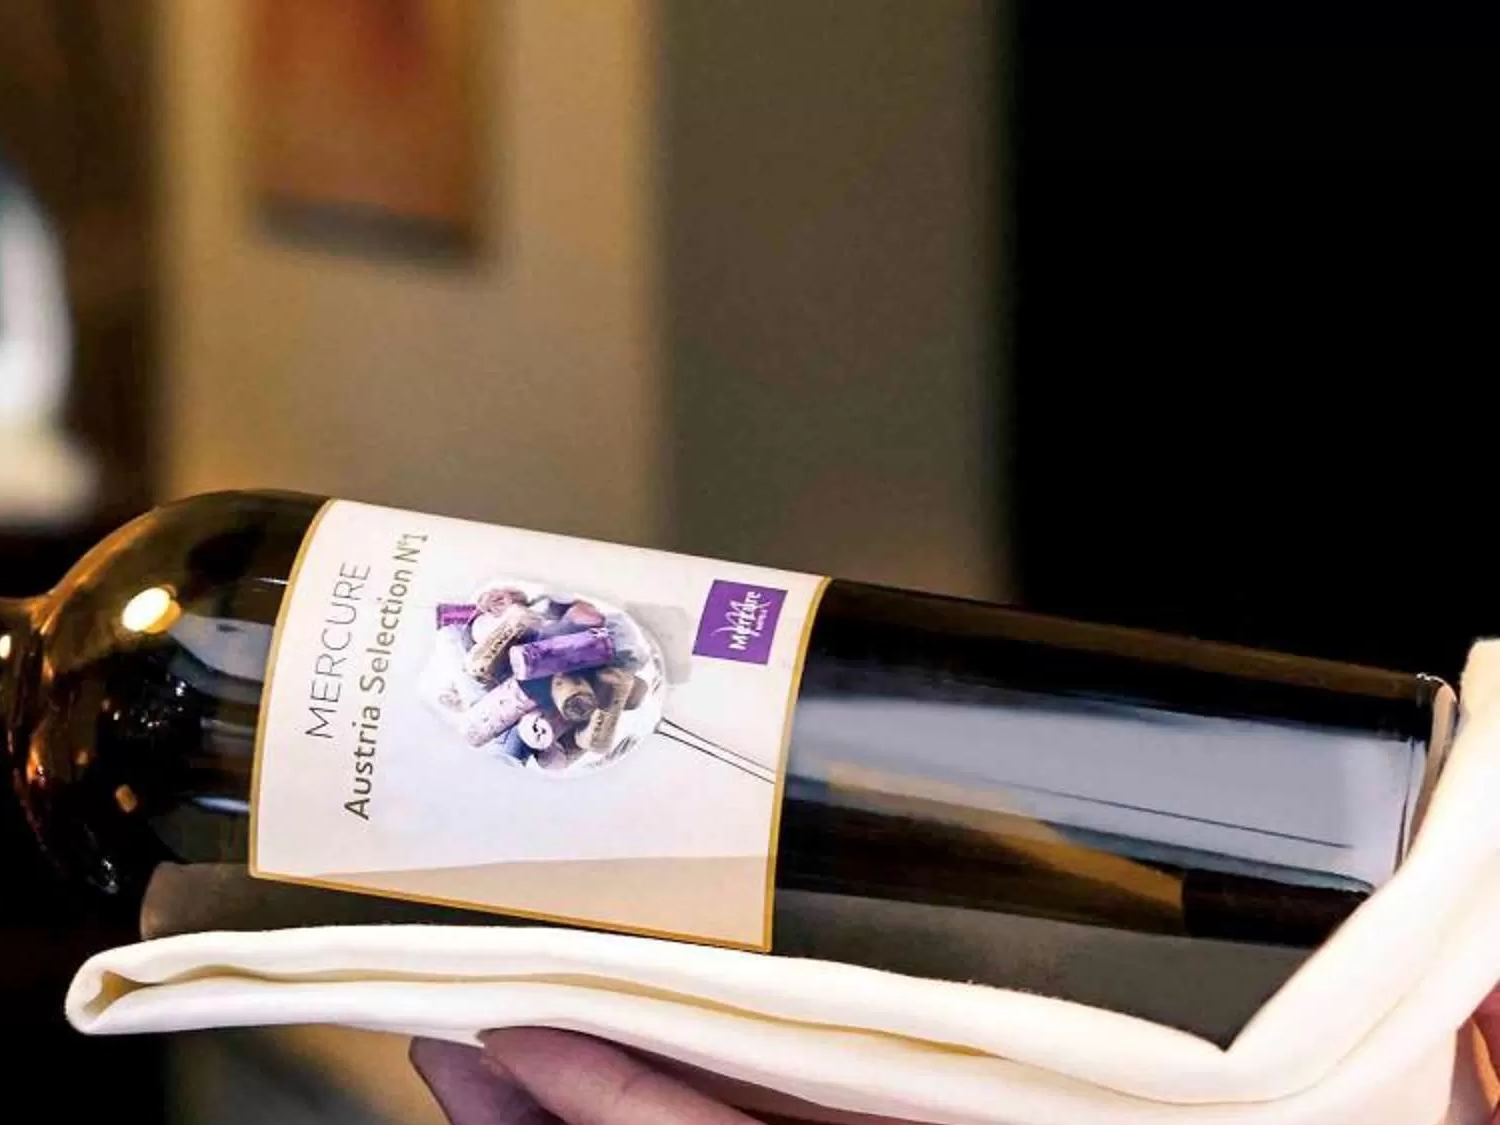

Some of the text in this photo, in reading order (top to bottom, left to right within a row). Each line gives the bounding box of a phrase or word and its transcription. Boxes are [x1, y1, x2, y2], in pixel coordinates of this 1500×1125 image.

[304, 562, 372, 739] MERCURE
[359, 568, 414, 695] Selection
[343, 705, 381, 821] Austria
